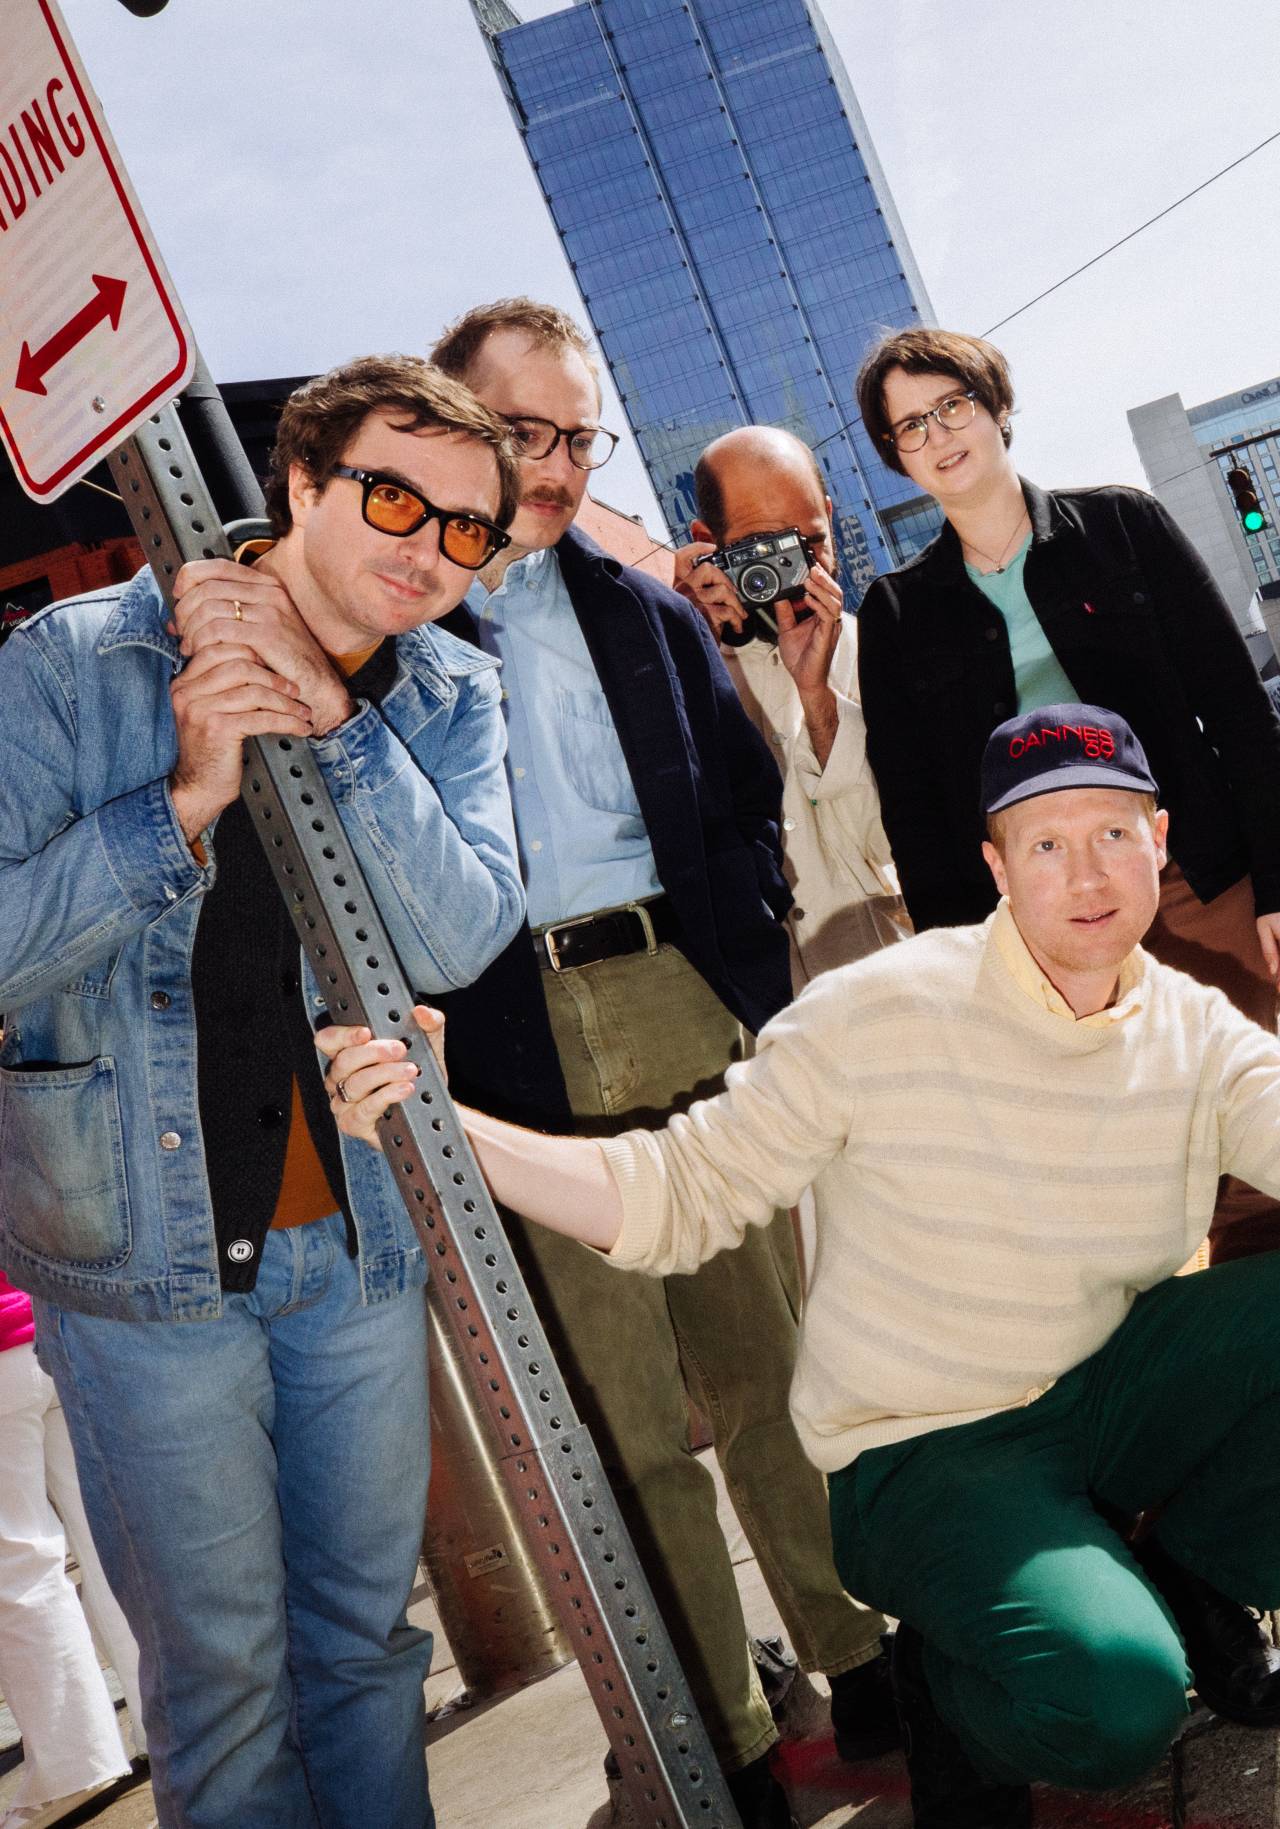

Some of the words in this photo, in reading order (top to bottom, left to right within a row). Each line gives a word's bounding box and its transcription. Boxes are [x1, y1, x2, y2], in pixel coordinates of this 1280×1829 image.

[0, 77, 86, 232] DING
[1009, 724, 1114, 759] CANNES
[1085, 740, 1115, 760] 69
